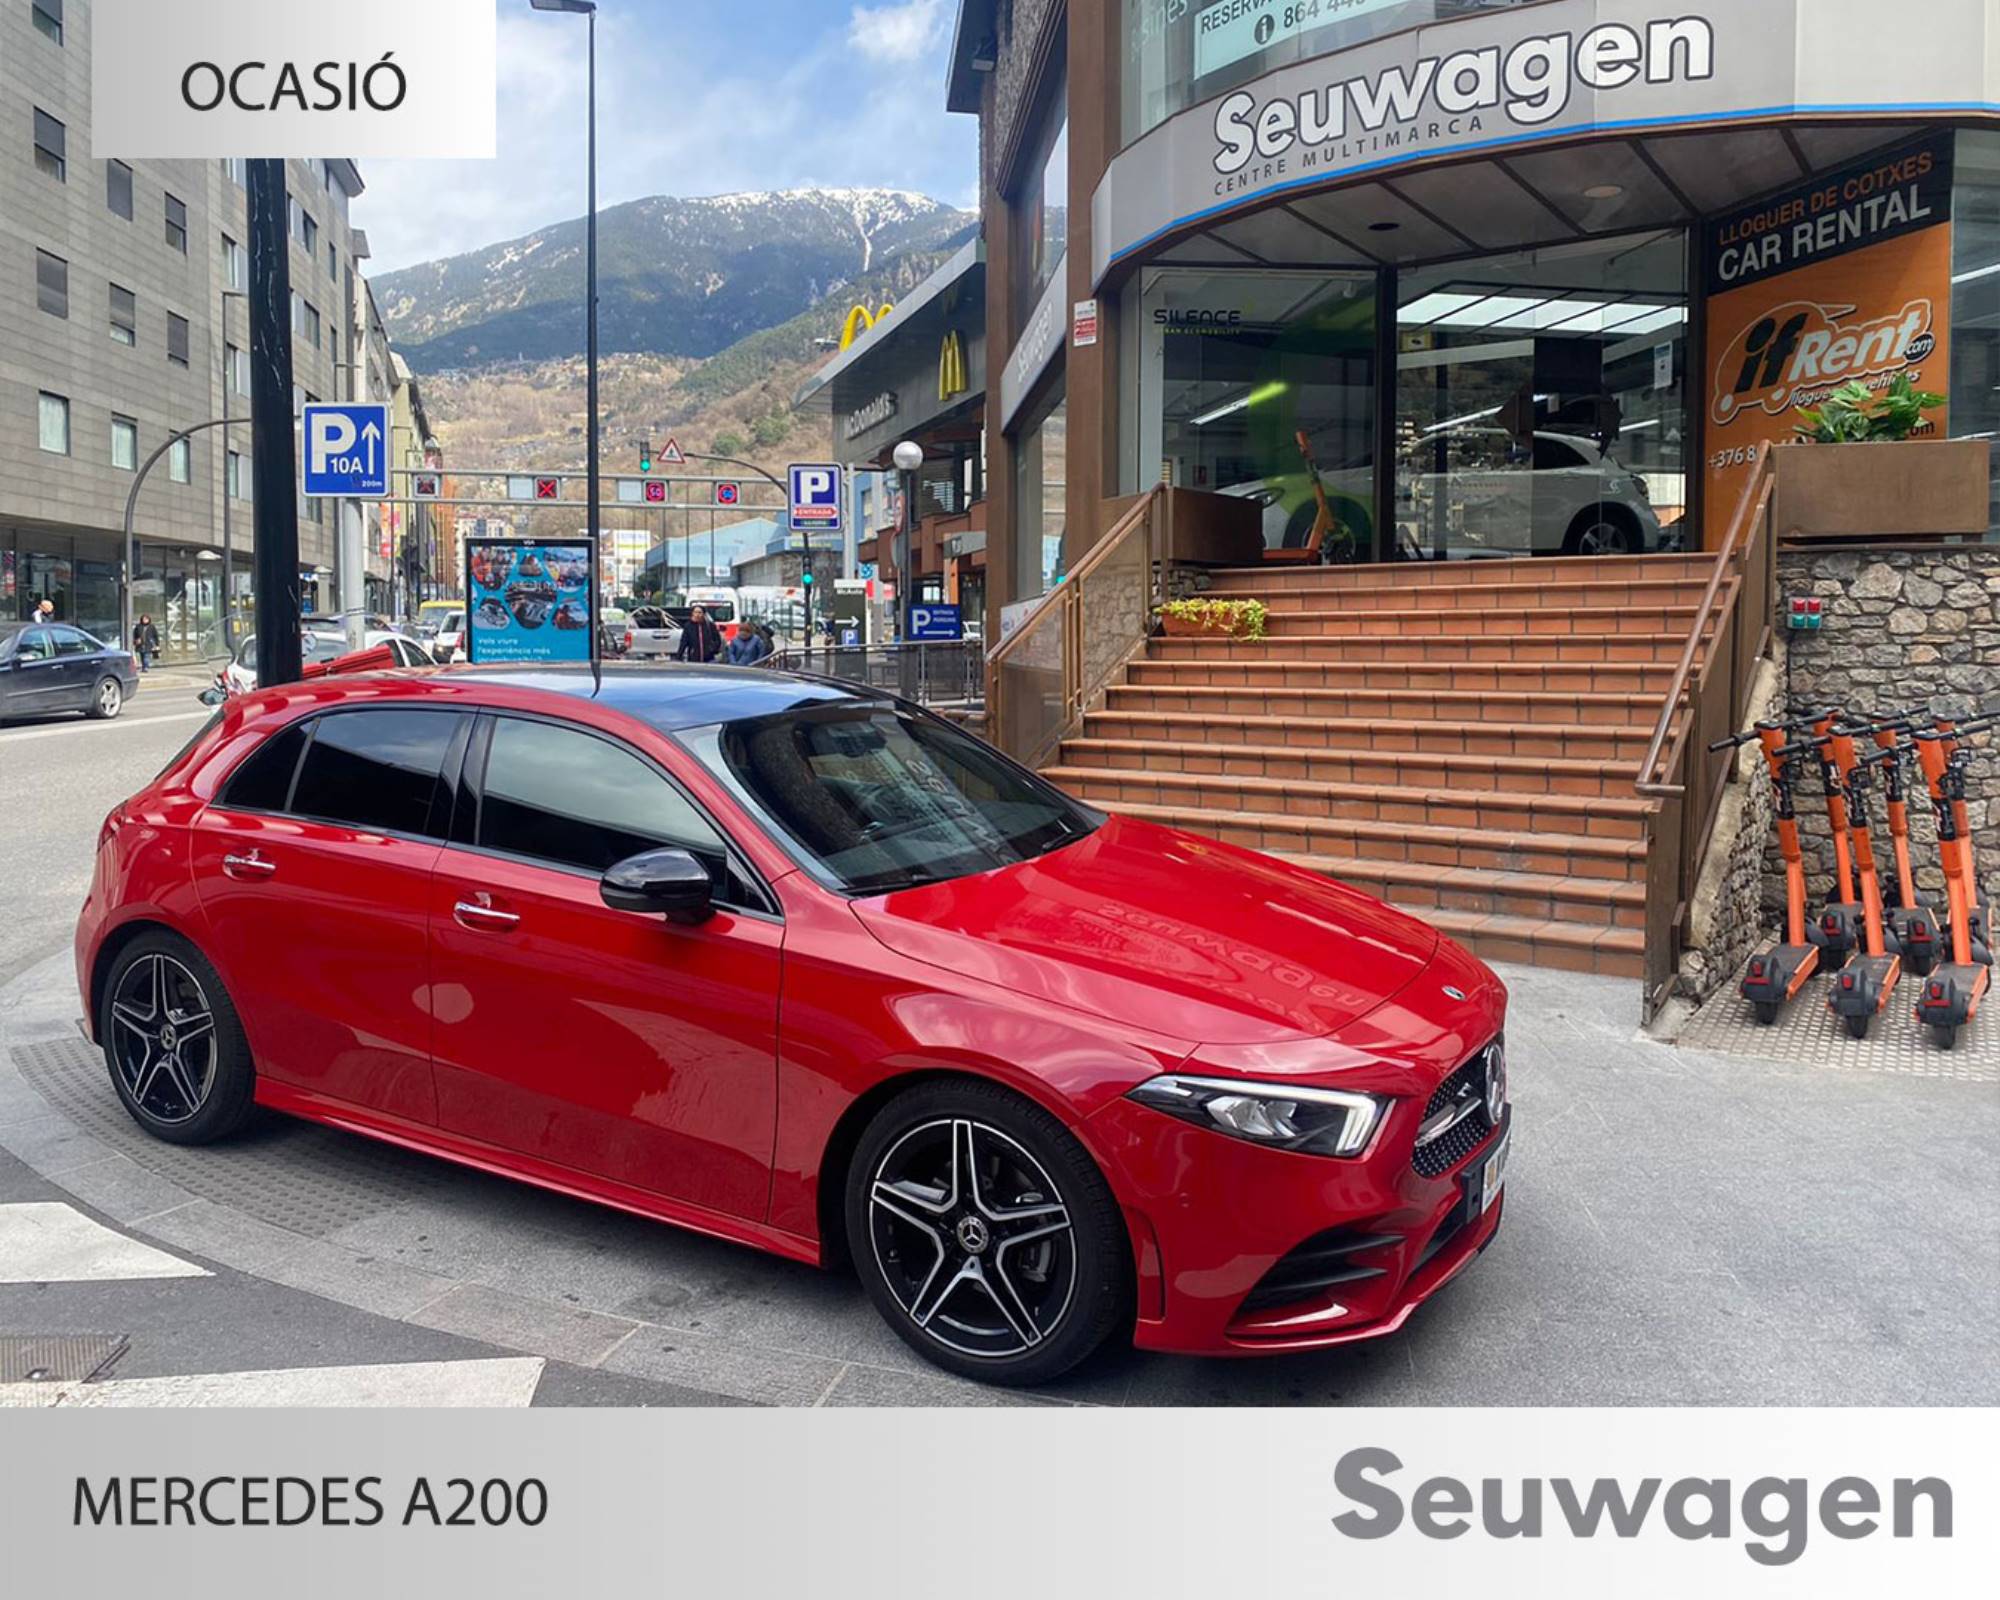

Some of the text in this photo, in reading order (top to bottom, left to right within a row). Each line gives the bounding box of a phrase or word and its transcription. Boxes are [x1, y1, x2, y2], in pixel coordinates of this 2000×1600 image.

[1283, 0, 1320, 28] 864
[1213, 15, 1714, 175] Seuwagen
[1214, 116, 1482, 196] CENTRE MULTIMARCA
[1719, 152, 1933, 246] LLOGUER DE COTXES
[1718, 183, 1932, 282] CAR RENTAL
[1153, 309, 1242, 325] SILENCE
[311, 413, 357, 474] P
[1709, 447, 1743, 468] +376
[330, 456, 364, 474] 10A
[361, 480, 382, 488] 200m
[800, 471, 830, 504] P
[912, 608, 931, 635] P
[844, 631, 855, 646] P
